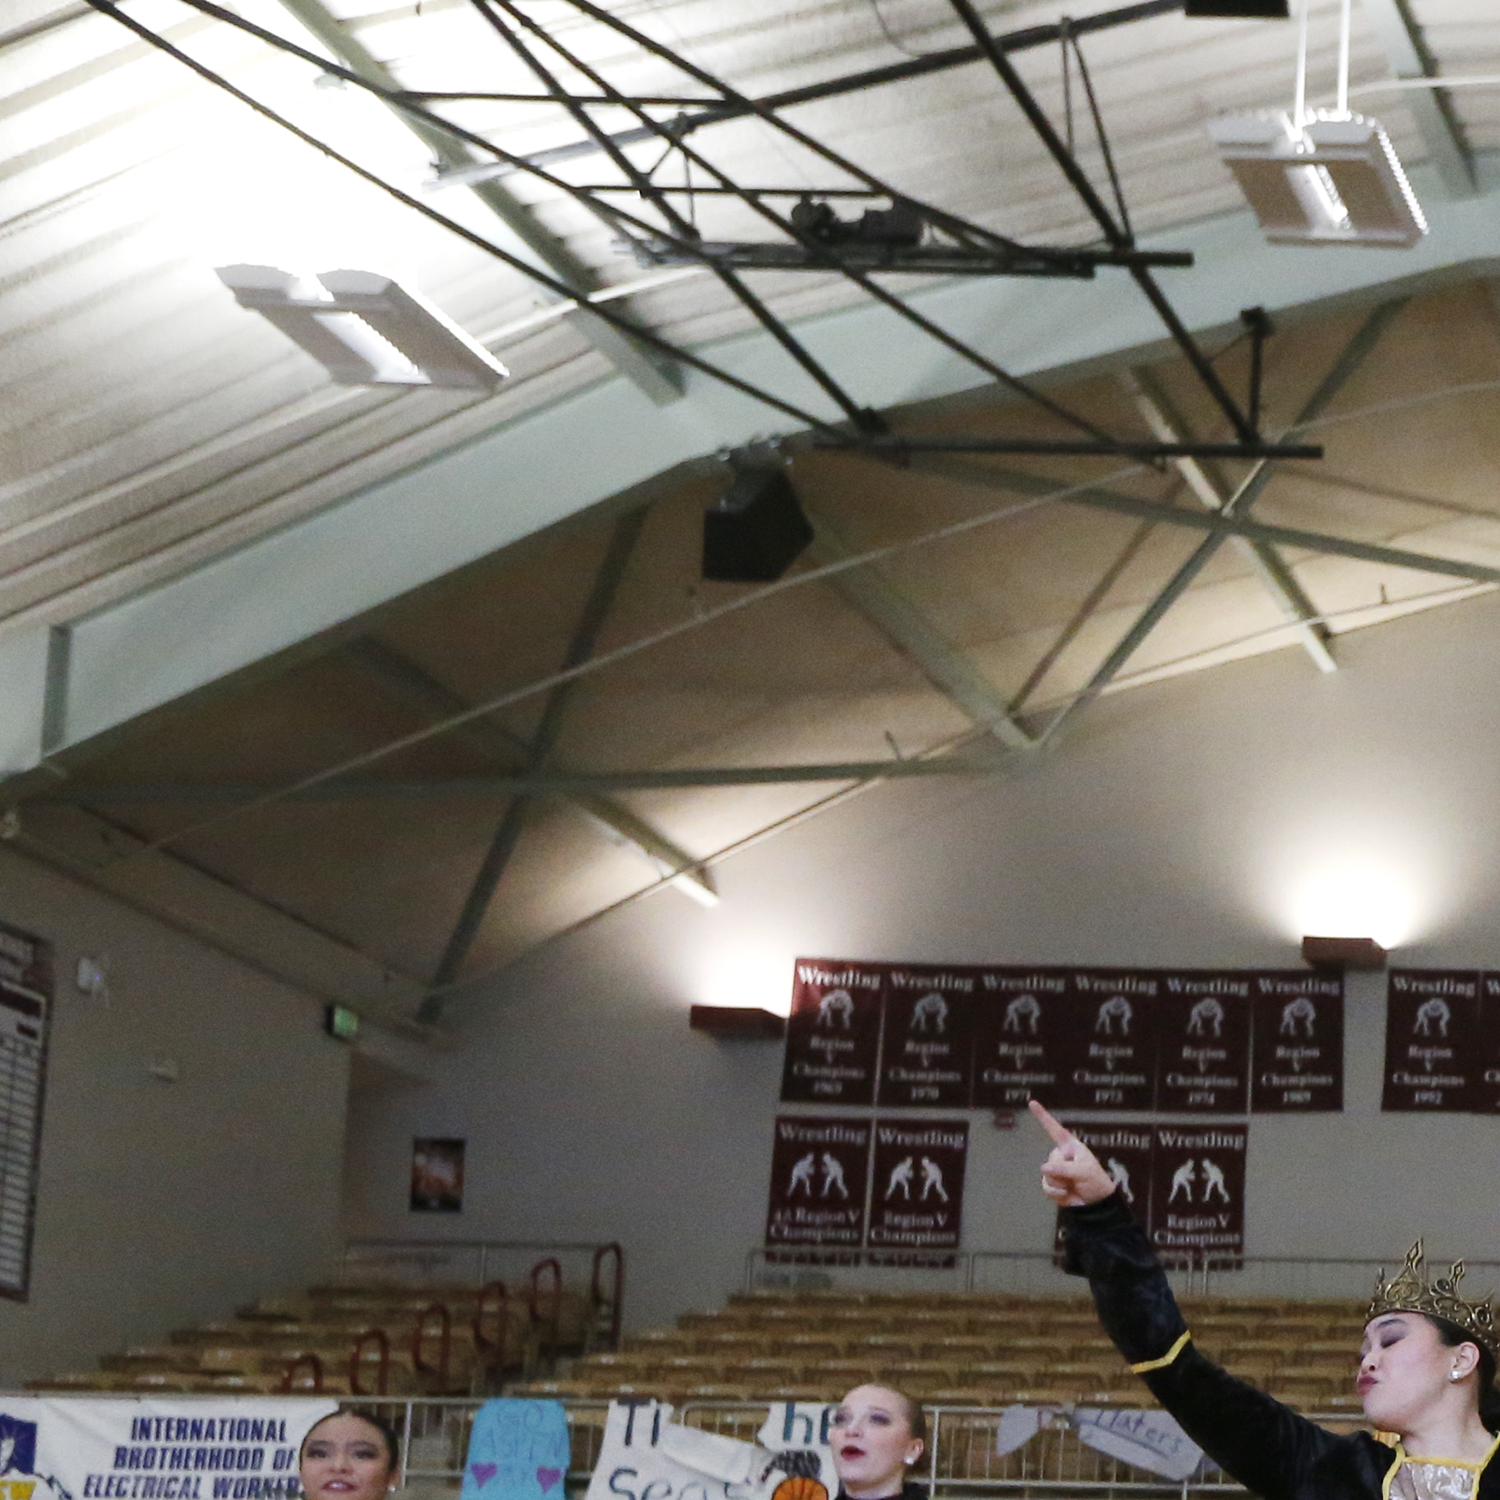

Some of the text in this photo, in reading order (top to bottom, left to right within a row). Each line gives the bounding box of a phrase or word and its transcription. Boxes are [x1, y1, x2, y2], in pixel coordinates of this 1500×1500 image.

[797, 966, 880, 989] Wrestling
[890, 971, 973, 992] Wrestling
[983, 974, 1065, 995] Wrestling
[1075, 975, 1158, 996] Wrestling
[1167, 976, 1249, 997] Wrestling
[1258, 977, 1341, 997] Wrestling
[1393, 976, 1476, 998] Wrestling
[793, 1063, 866, 1080] Champions
[889, 1068, 962, 1083] Champions
[983, 1069, 1055, 1085] Champions
[1073, 1070, 1146, 1087] Champions
[1166, 1072, 1239, 1089] Champions
[1262, 1072, 1333, 1087] Champions
[1392, 1071, 1465, 1090] Champions
[780, 1122, 866, 1146] Wrestling
[878, 1128, 964, 1149] Wrestling
[1159, 1130, 1244, 1151] Wrestling
[795, 1207, 845, 1226] Region
[884, 1210, 934, 1229] Region
[1168, 1214, 1216, 1232] Region
[770, 1225, 859, 1244] Champions
[871, 1228, 956, 1247] Champions
[1154, 1230, 1241, 1249] Champions
[131, 1416, 287, 1442] INTERNATIONAL
[114, 1446, 298, 1471] BROTHERHOOD OF
[83, 1473, 202, 1499] ELECTRICAL
